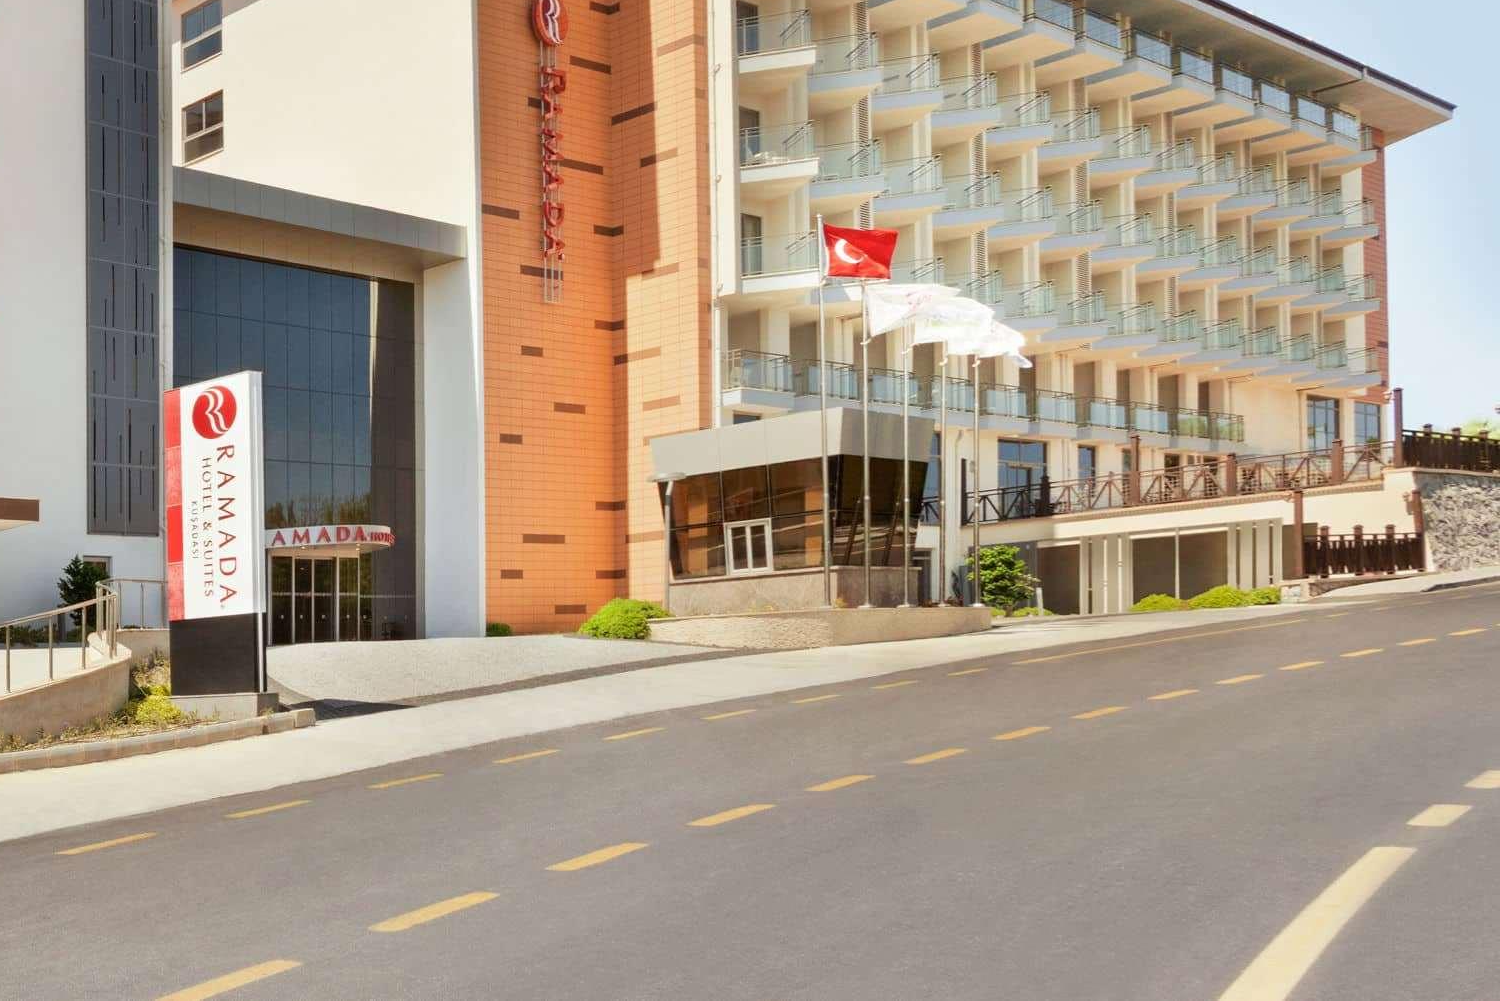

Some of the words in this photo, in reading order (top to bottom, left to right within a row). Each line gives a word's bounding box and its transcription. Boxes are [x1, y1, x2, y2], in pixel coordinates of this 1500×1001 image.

[541, 66, 567, 257] RAMADA
[202, 457, 213, 512] HOTEL
[203, 521, 212, 531] &
[217, 445, 238, 603] RAMADA
[271, 526, 368, 546] AMADA
[203, 540, 214, 597] SUITES
